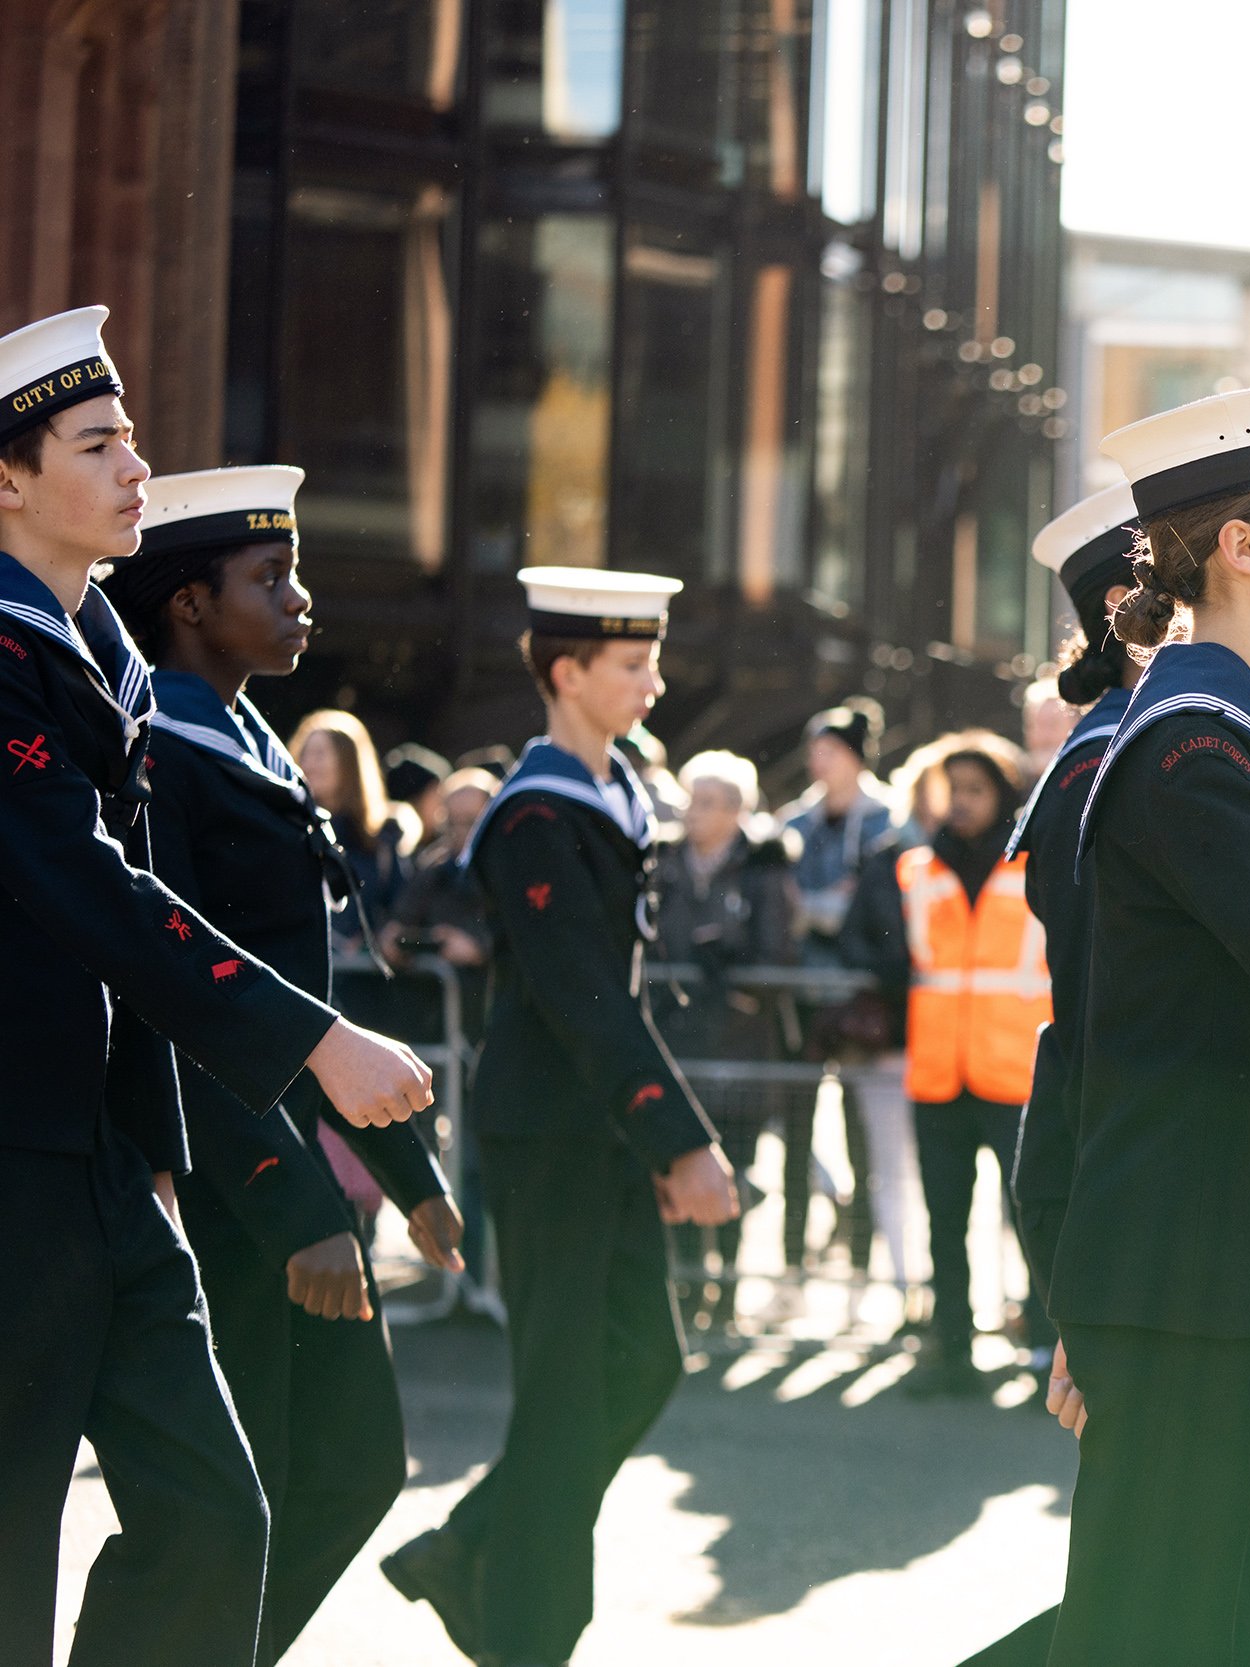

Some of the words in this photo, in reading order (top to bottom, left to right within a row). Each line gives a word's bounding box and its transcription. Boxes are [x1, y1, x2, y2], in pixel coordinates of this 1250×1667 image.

[13, 380, 55, 412] CITY
[60, 368, 82, 389] OF
[1161, 750, 1182, 772] SEA
[1181, 736, 1221, 753] CADET
